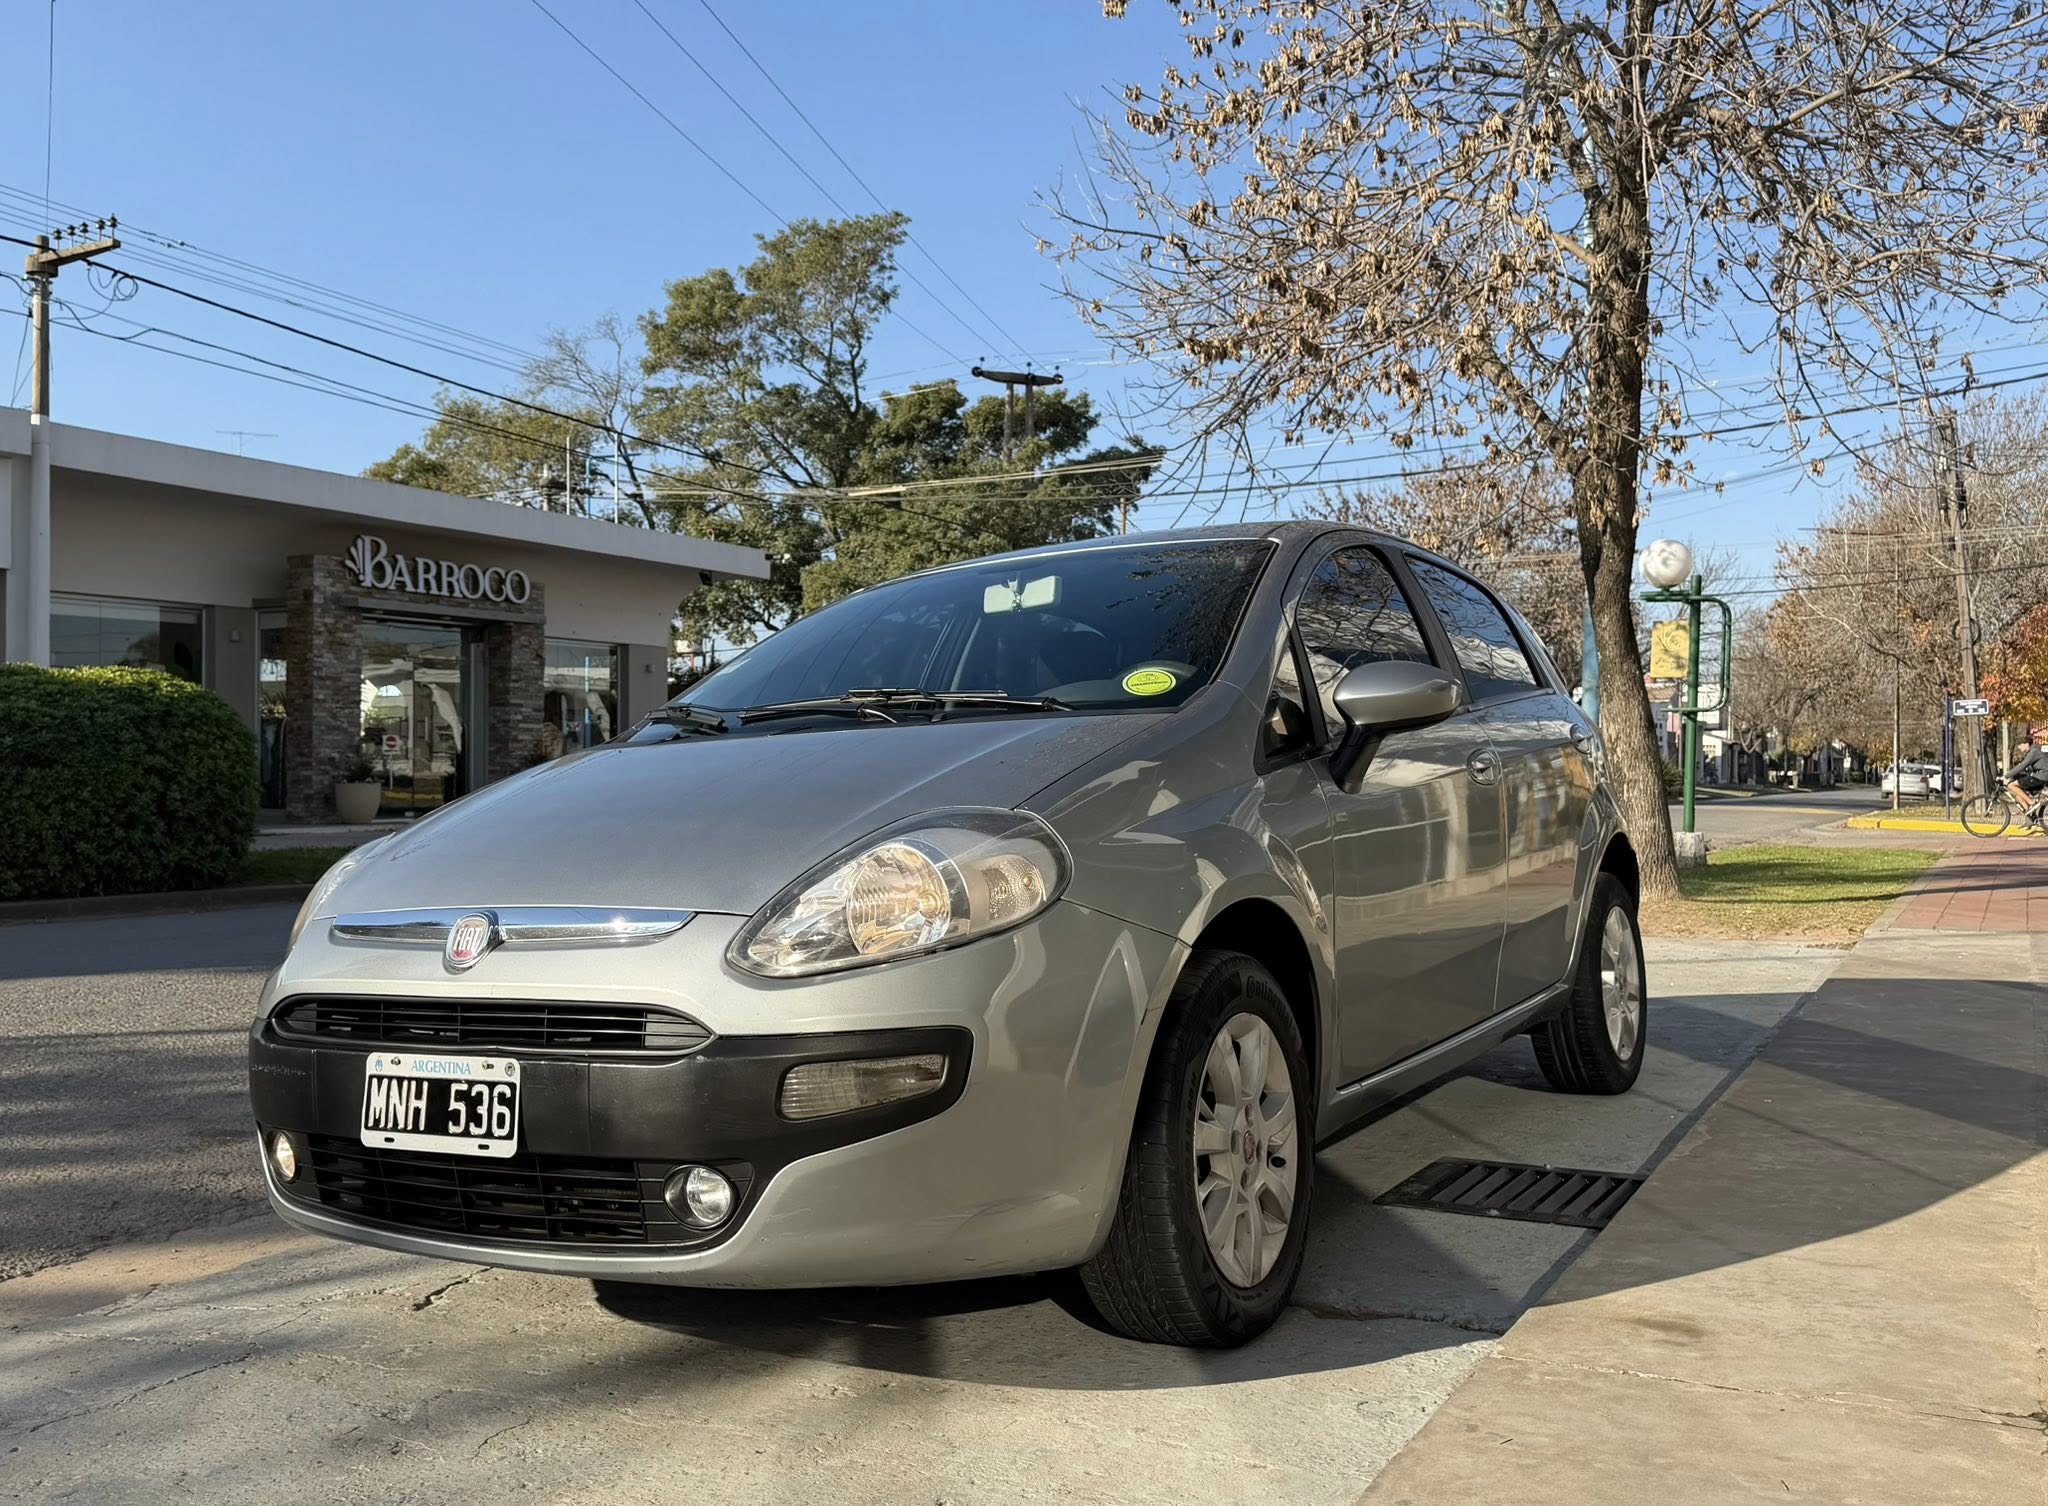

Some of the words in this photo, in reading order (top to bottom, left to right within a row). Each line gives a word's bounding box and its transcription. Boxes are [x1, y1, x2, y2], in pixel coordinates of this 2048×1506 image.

[361, 535, 531, 604] BARROCO
[453, 927, 482, 951] FIAT
[411, 1060, 471, 1075] ARGENTINA
[368, 1078, 428, 1131] MNH
[448, 1081, 512, 1137] 536
